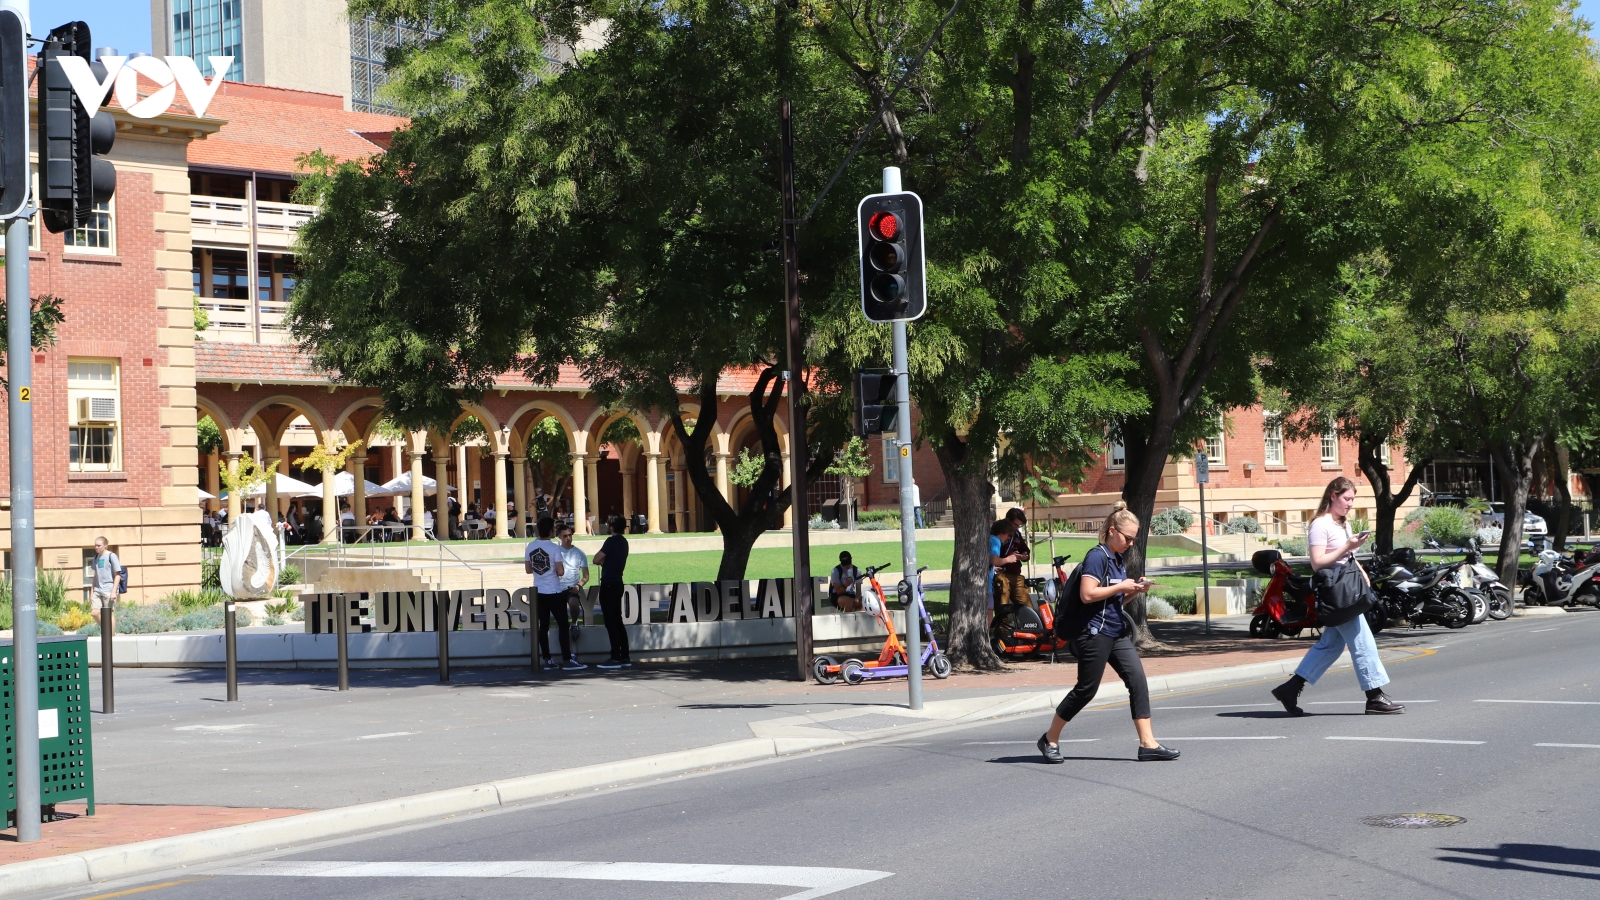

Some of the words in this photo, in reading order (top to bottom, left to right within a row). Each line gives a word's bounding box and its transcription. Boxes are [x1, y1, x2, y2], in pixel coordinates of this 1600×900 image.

[21, 387, 30, 401] 2
[902, 448, 908, 457] 3
[299, 592, 372, 634] THE
[374, 586, 600, 633] UNIVERSY
[620, 584, 661, 625] OF
[668, 577, 833, 623] ADELAIE
